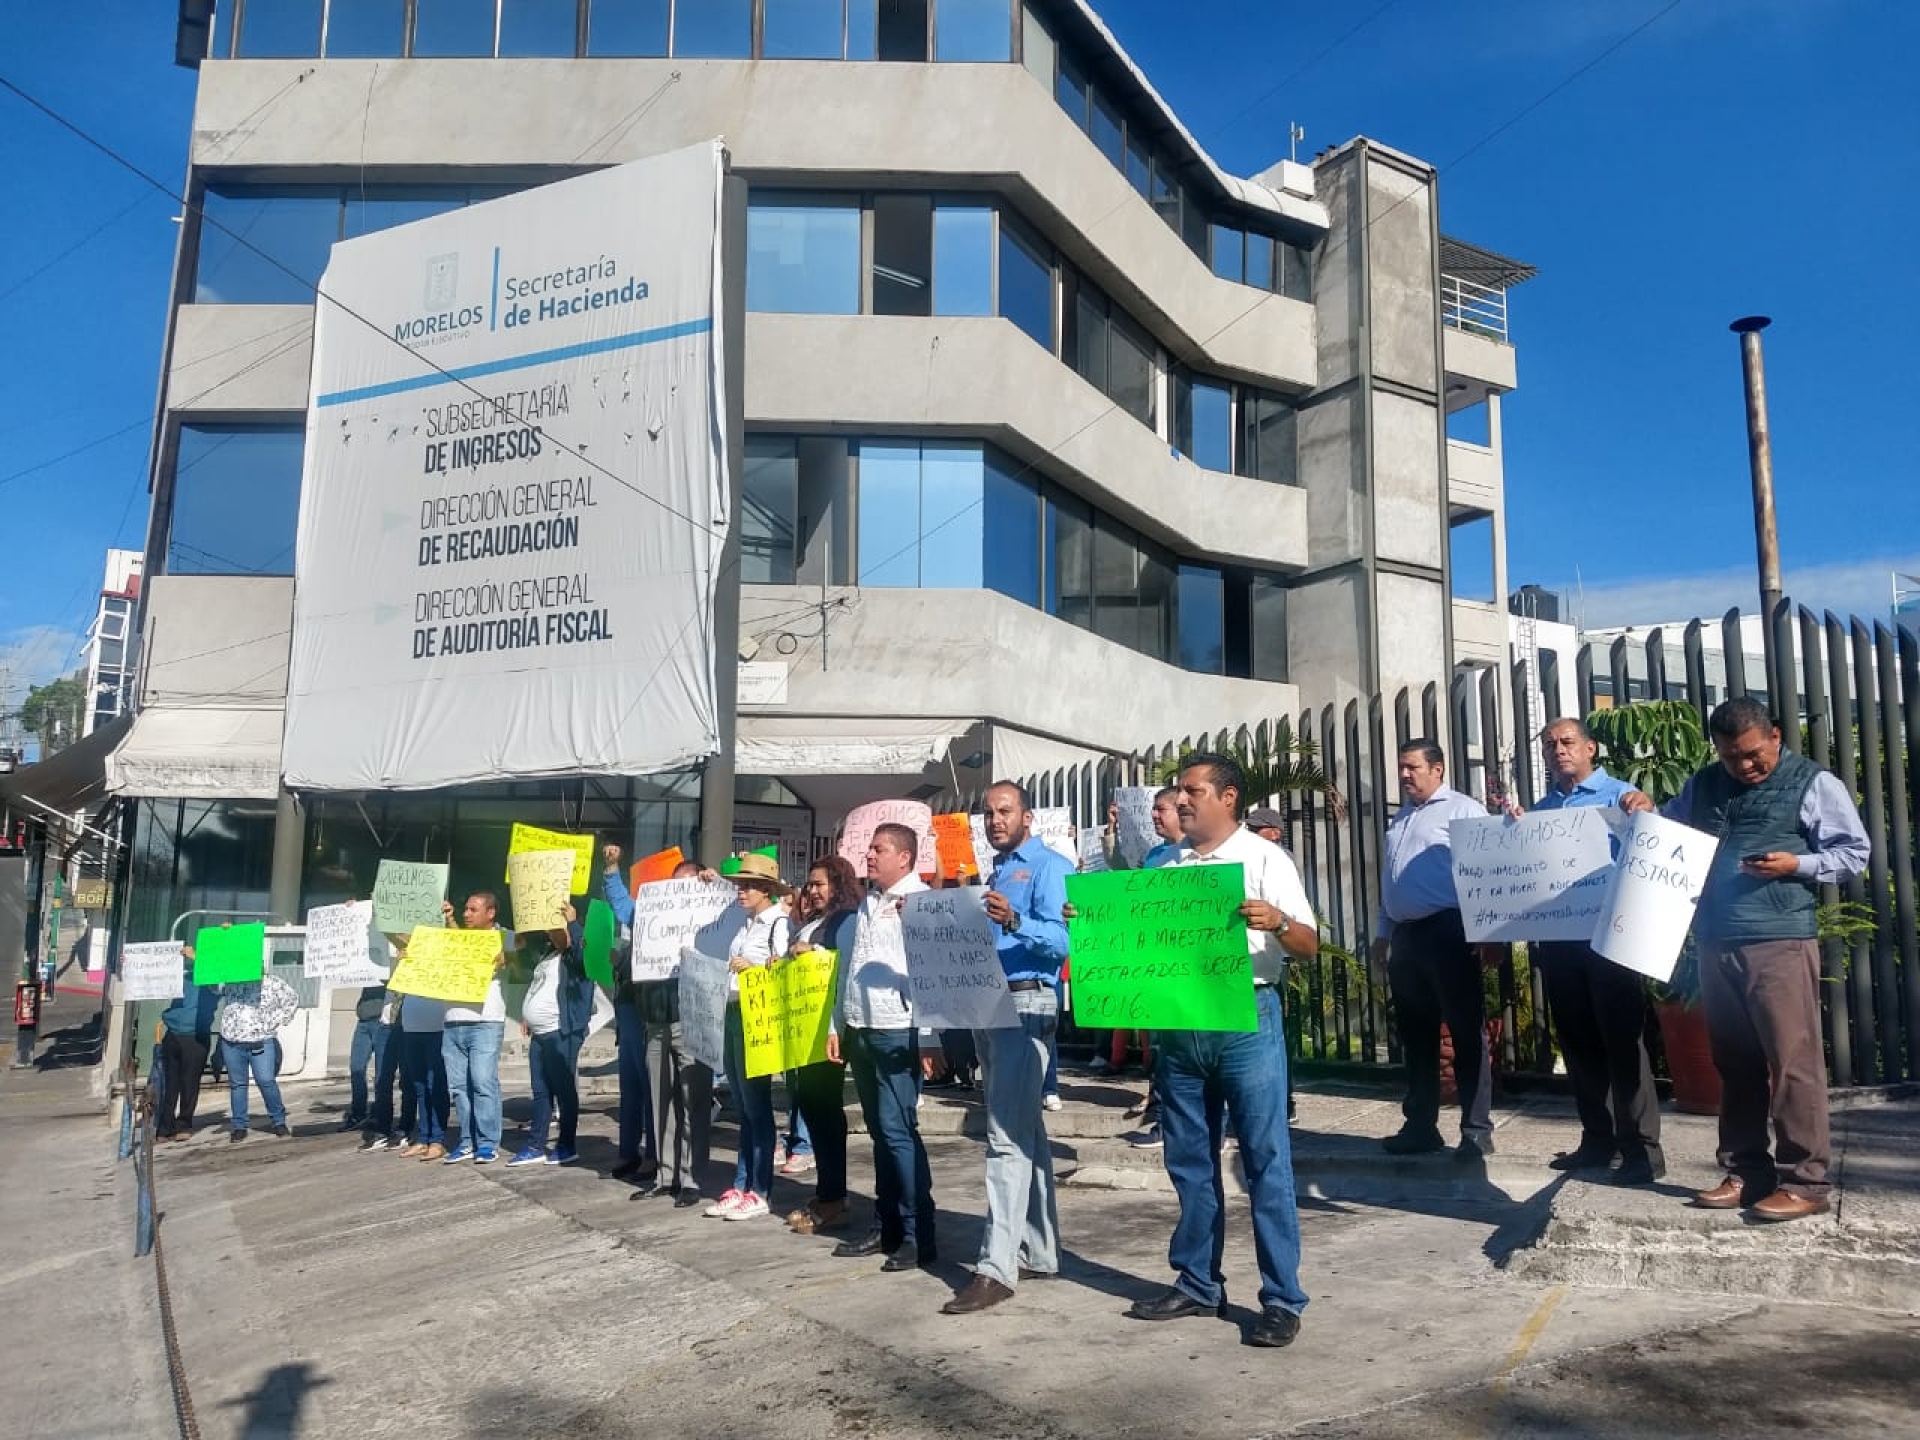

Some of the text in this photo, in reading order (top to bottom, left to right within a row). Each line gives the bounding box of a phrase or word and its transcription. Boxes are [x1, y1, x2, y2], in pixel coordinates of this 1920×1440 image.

[504, 276, 649, 328] de Hacienda
[505, 254, 616, 300] Secretaría
[395, 305, 484, 341] MORELOS
[426, 381, 569, 438] SUBSECRETARÍA
[424, 426, 542, 474] DE INGRESOS
[421, 476, 597, 530] DIRECCIÓN GENERAL
[419, 511, 579, 566] DE RECAUDACIÓN
[415, 573, 594, 623] DIRECCIÓN GENERAL
[412, 609, 613, 659] DE AUDITORÍA FISCAL
[1671, 844, 1685, 862] A
[1136, 930, 1146, 949] A
